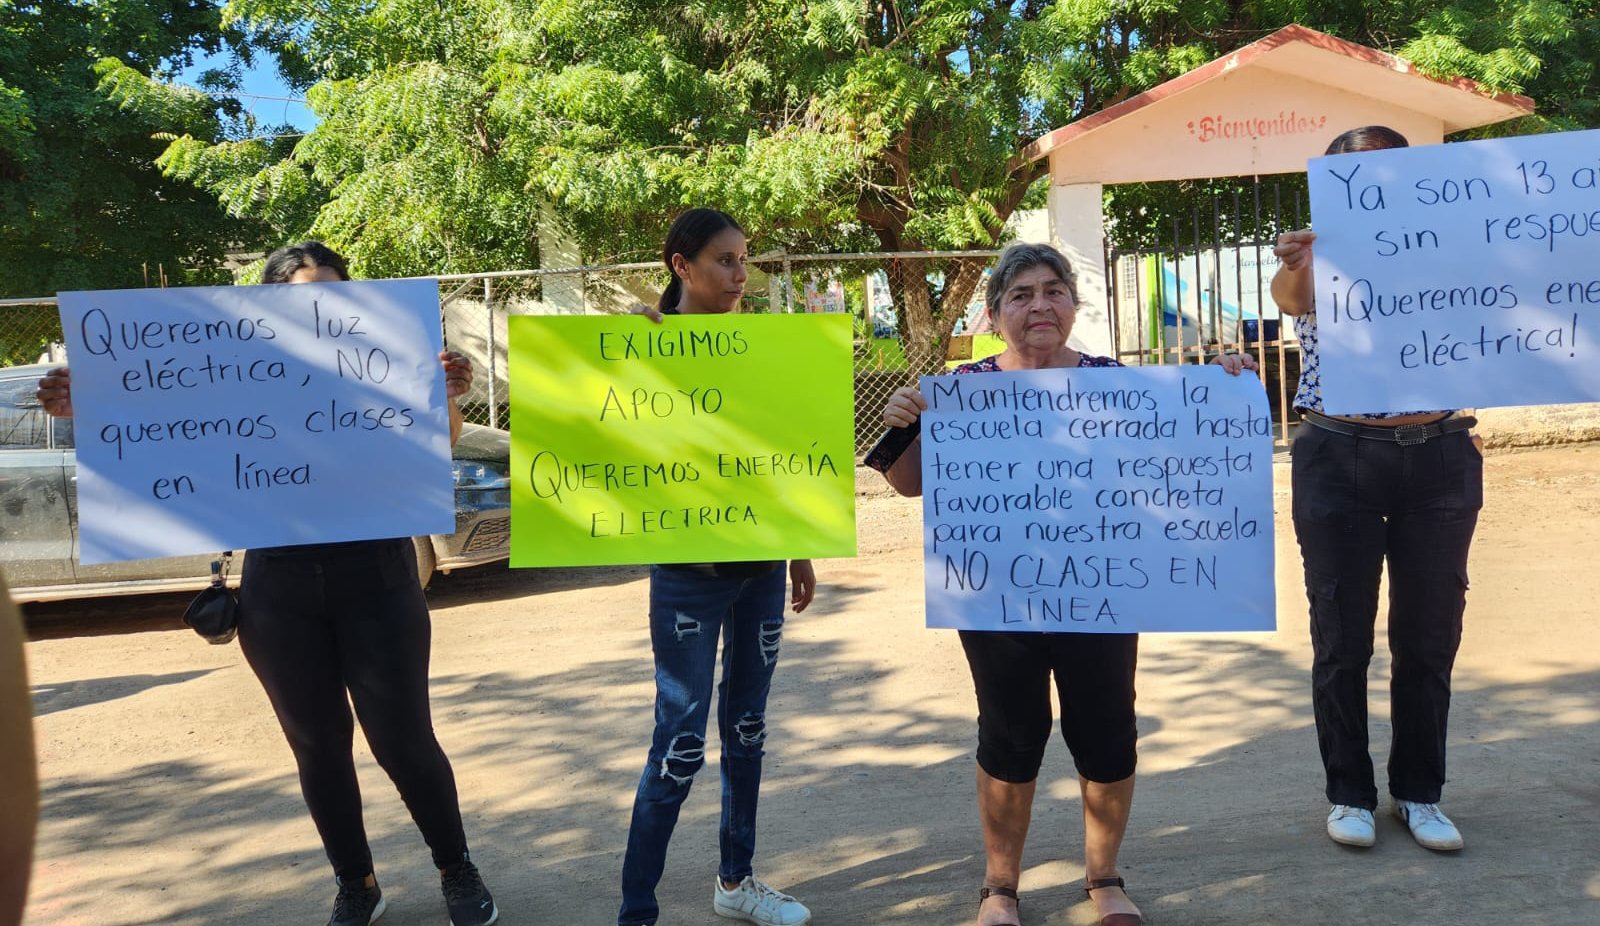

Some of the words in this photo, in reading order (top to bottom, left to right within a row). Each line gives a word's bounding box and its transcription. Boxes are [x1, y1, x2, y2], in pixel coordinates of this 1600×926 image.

[1200, 111, 1316, 142] Bienvenidos
[1328, 164, 1386, 211] Ya
[1415, 177, 1491, 205] son
[1517, 161, 1555, 195] 13
[1572, 159, 1600, 189] a
[1375, 227, 1439, 257] sin
[1331, 276, 1518, 324] ¡Queremos
[81, 306, 277, 361] Queremos
[313, 299, 367, 340] luz
[600, 330, 749, 361] EXIGIMOS
[1400, 313, 1578, 369] eléctrica!
[121, 353, 311, 393] eléctrica,
[337, 347, 390, 385] NO
[600, 386, 723, 421] APOYO
[932, 377, 1158, 412] Mantendremos
[1182, 377, 1209, 407] la
[100, 413, 278, 460] queremos
[305, 399, 415, 435] clases
[929, 414, 1043, 443] escuela
[1068, 410, 1178, 439] cerrada
[1196, 405, 1271, 438] hasta
[153, 473, 195, 500] en
[530, 451, 700, 503] QUEREMOS
[718, 442, 839, 478] ENERGÍA
[930, 452, 1022, 481] tener
[1037, 461, 1093, 479] una
[1117, 446, 1253, 488] respuesta
[933, 483, 1073, 517] favorable
[1096, 480, 1224, 509] concreta
[591, 505, 758, 538] ELECTRICA
[932, 521, 1002, 554] para
[1025, 514, 1142, 544] nuestra
[1164, 507, 1263, 541] escuela.
[945, 550, 989, 592] NO
[1010, 554, 1149, 589] CLASES
[1170, 555, 1218, 591] EN
[1001, 588, 1120, 626] LÍNEA
